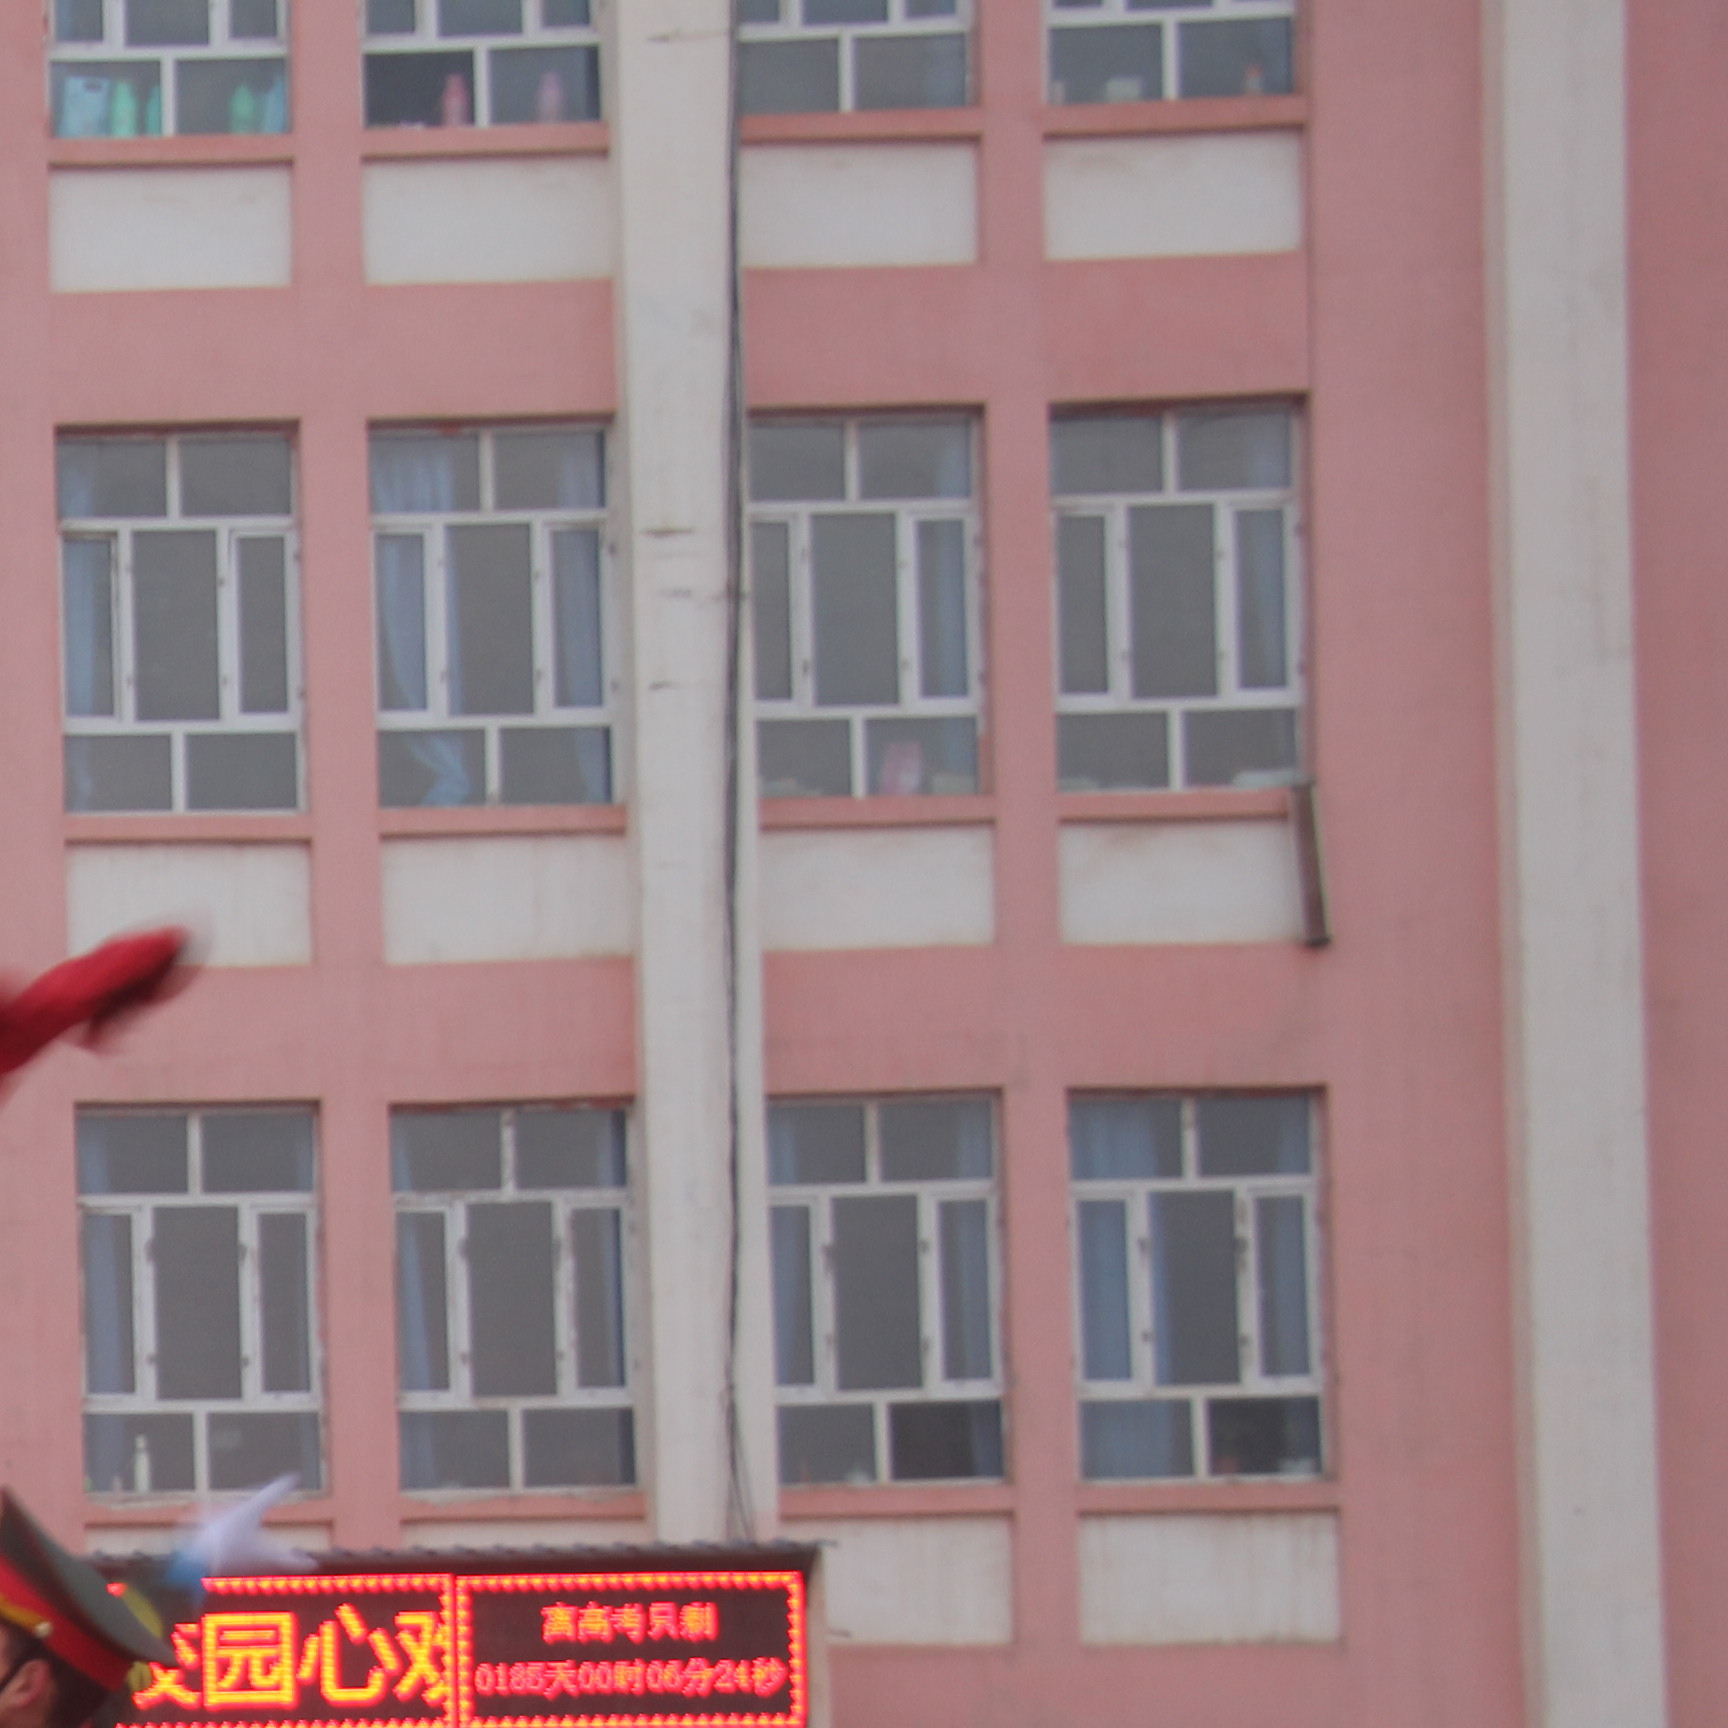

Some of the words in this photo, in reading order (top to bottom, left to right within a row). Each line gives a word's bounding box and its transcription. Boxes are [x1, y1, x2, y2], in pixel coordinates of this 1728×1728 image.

[541, 1602, 718, 1644] 离高考只剩
[474, 1657, 788, 1700] 0185天00时06分24秒
